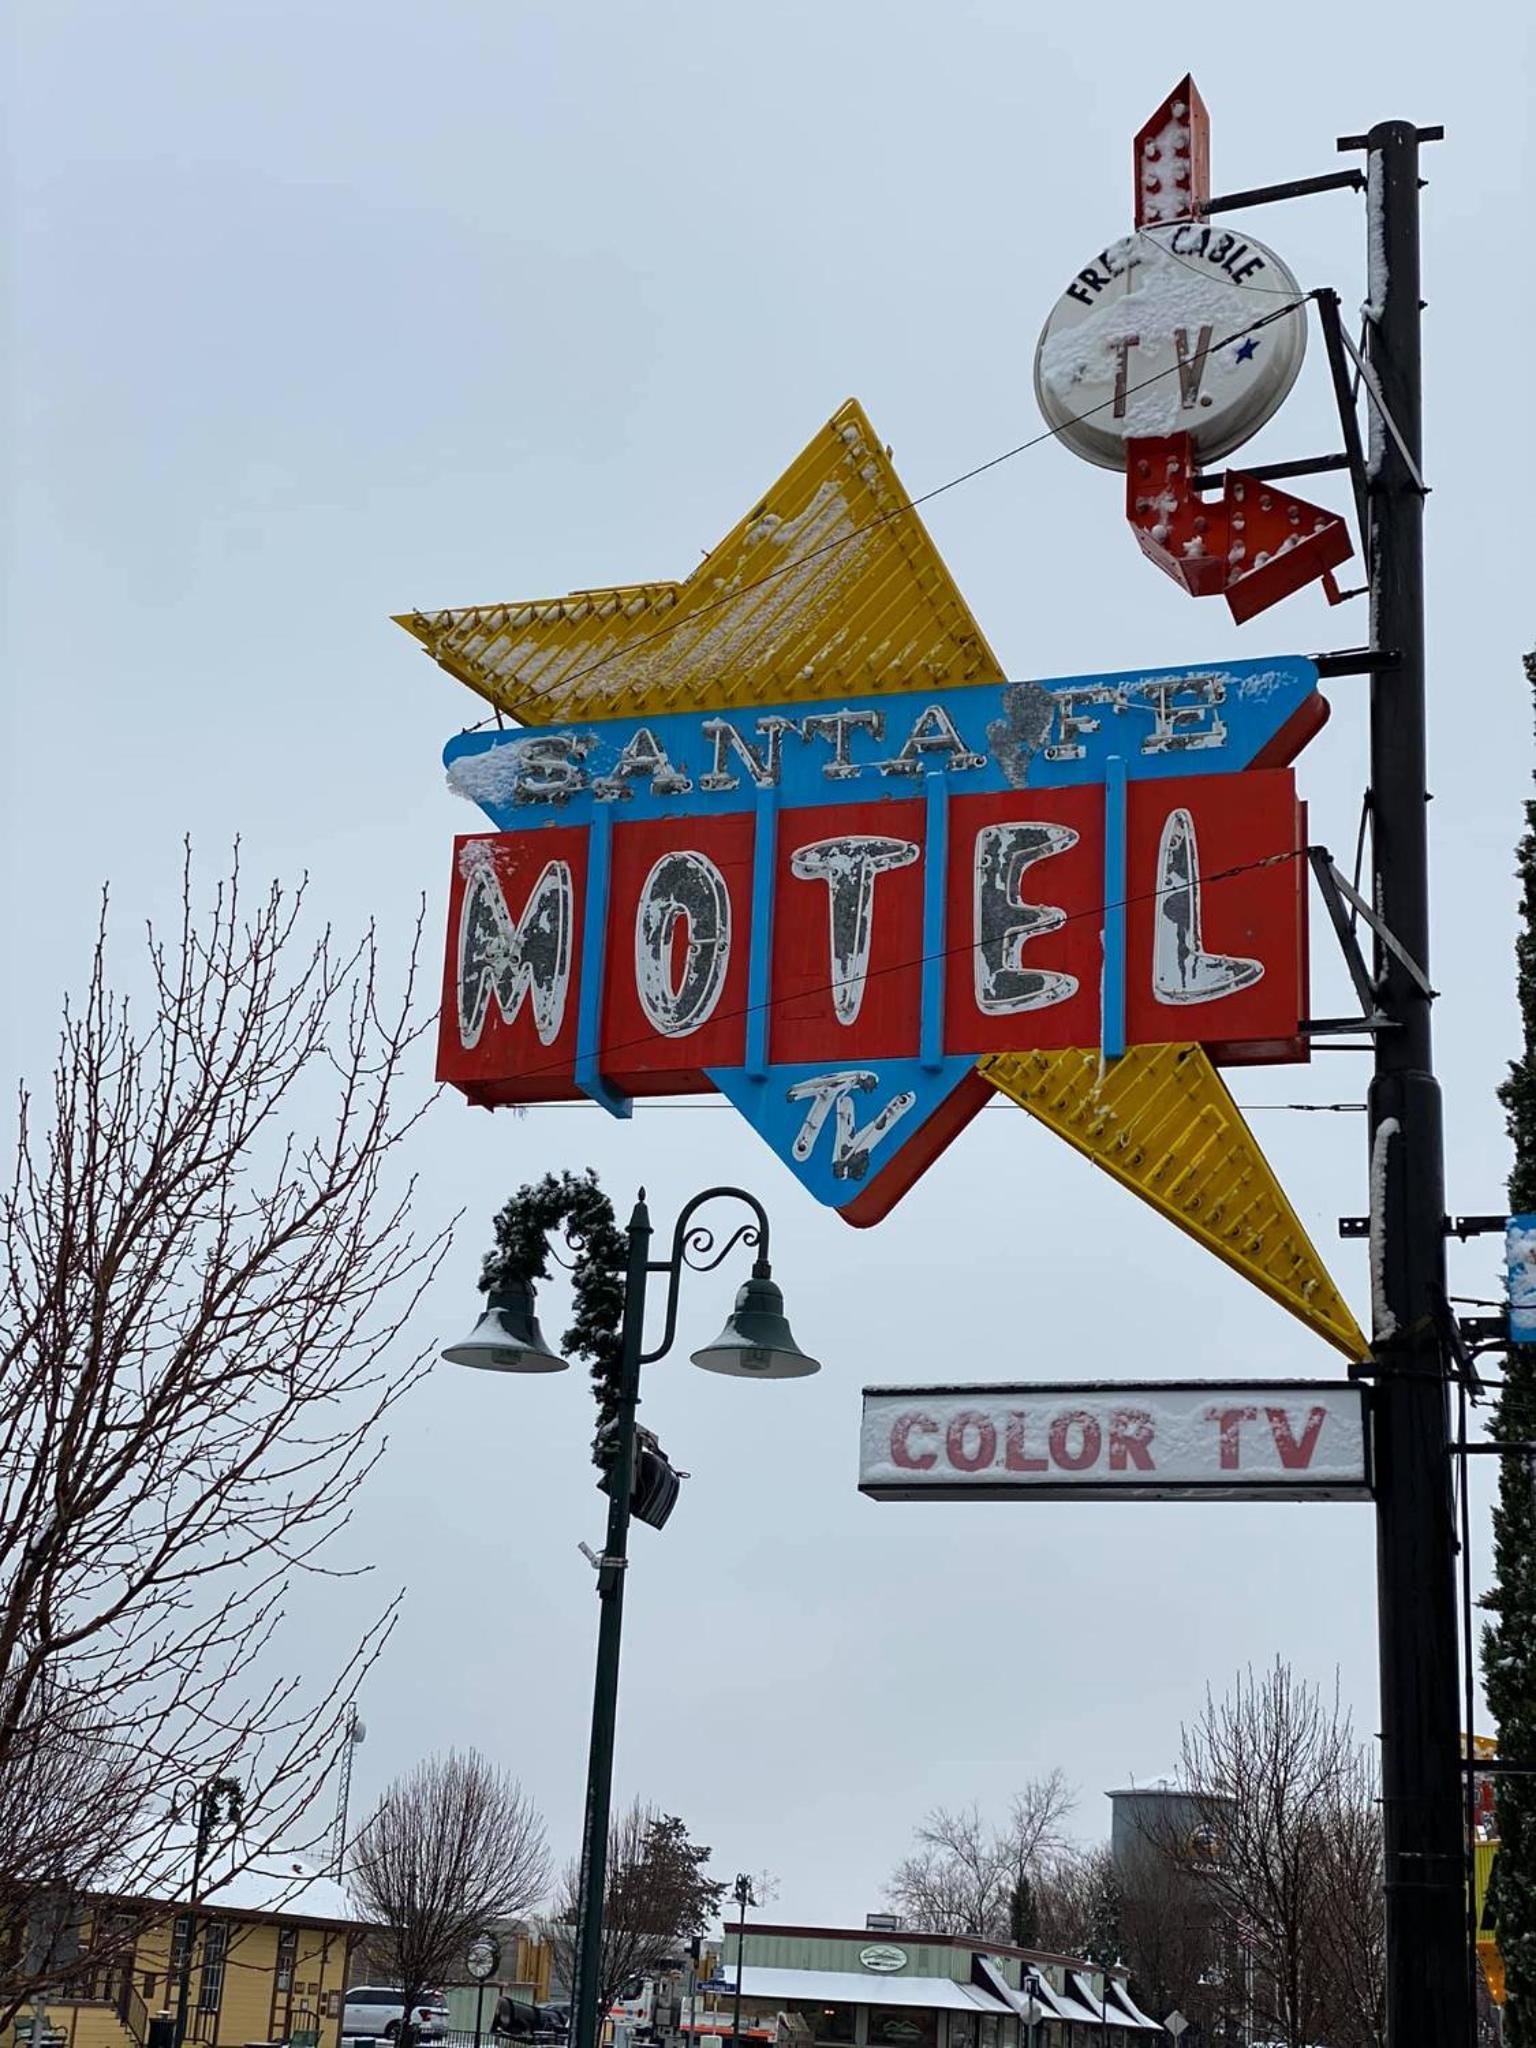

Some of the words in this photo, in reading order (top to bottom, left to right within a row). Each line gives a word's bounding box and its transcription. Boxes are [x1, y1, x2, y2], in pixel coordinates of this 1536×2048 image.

[1171, 225, 1266, 285] CABLE
[512, 704, 988, 803] SANTA
[1043, 671, 1228, 761] FE
[457, 807, 1265, 1051] MOTEL
[889, 1407, 1156, 1472] COLOR
[1203, 1404, 1328, 1471] TV
